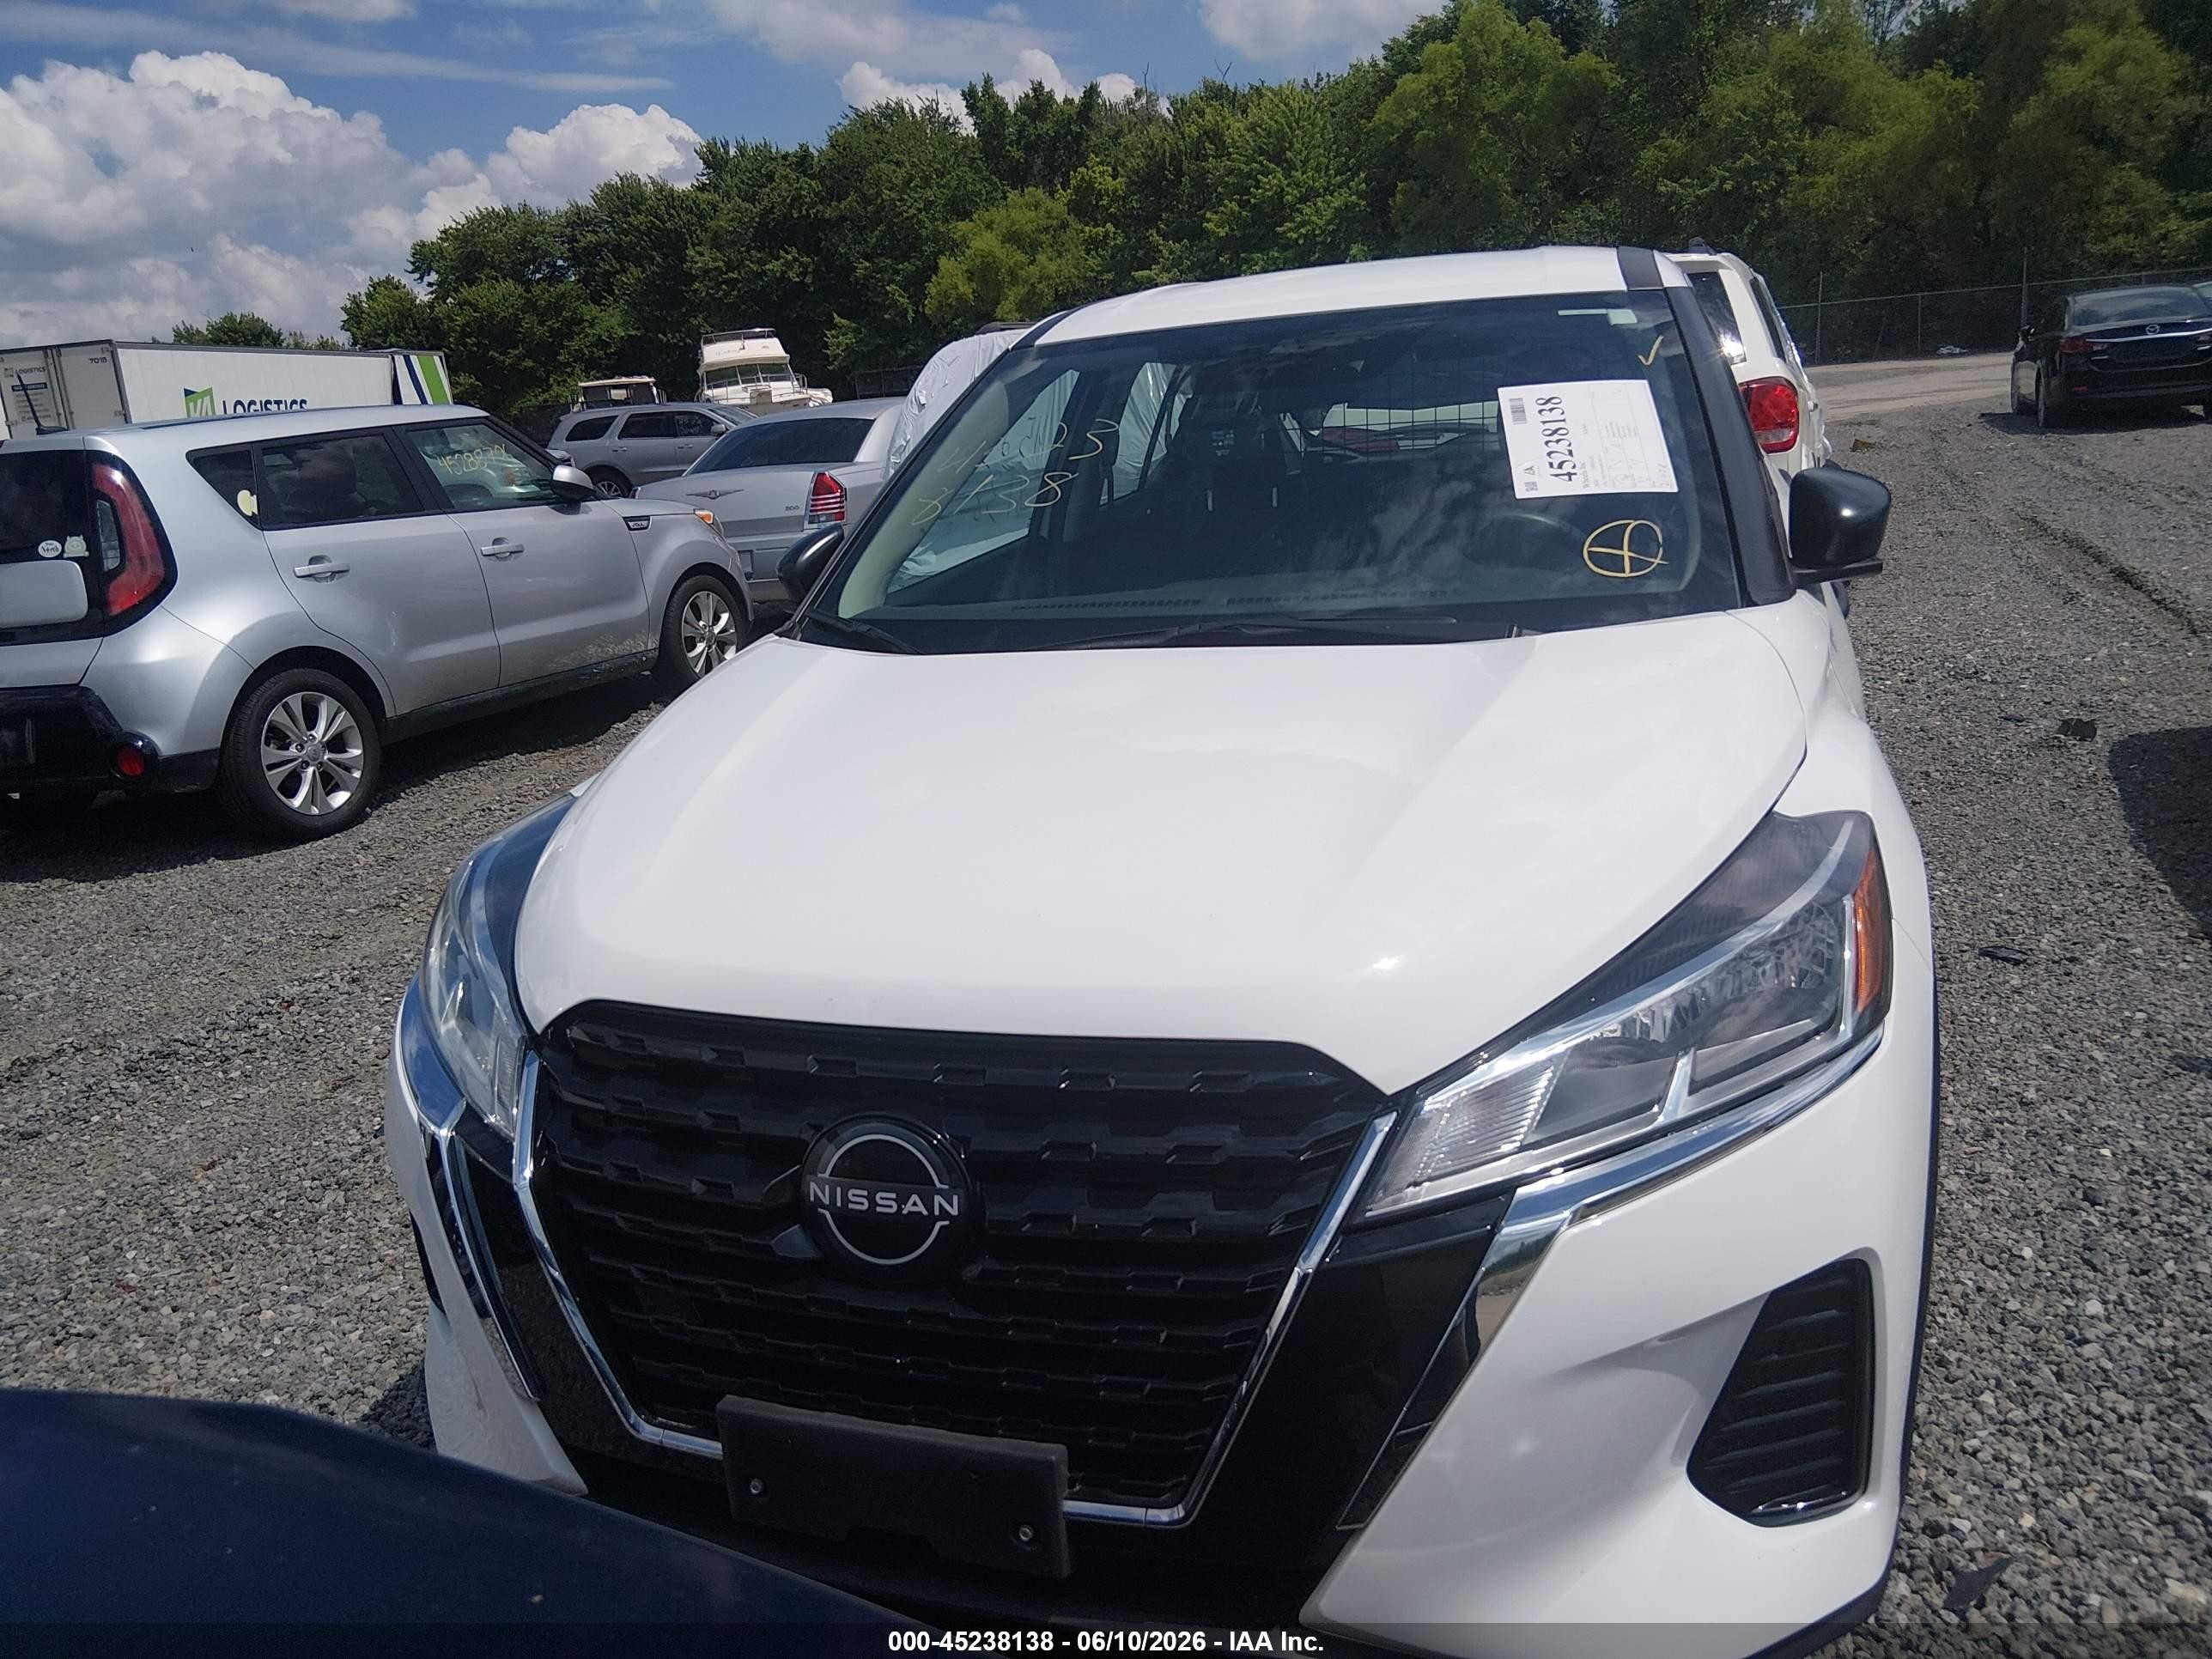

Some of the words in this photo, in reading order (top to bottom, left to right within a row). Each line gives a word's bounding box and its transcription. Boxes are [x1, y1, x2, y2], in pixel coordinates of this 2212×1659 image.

[222, 398, 307, 415] LOGISTICS
[1535, 396, 1578, 483] 45238138
[810, 1181, 959, 1216] NISSAN
